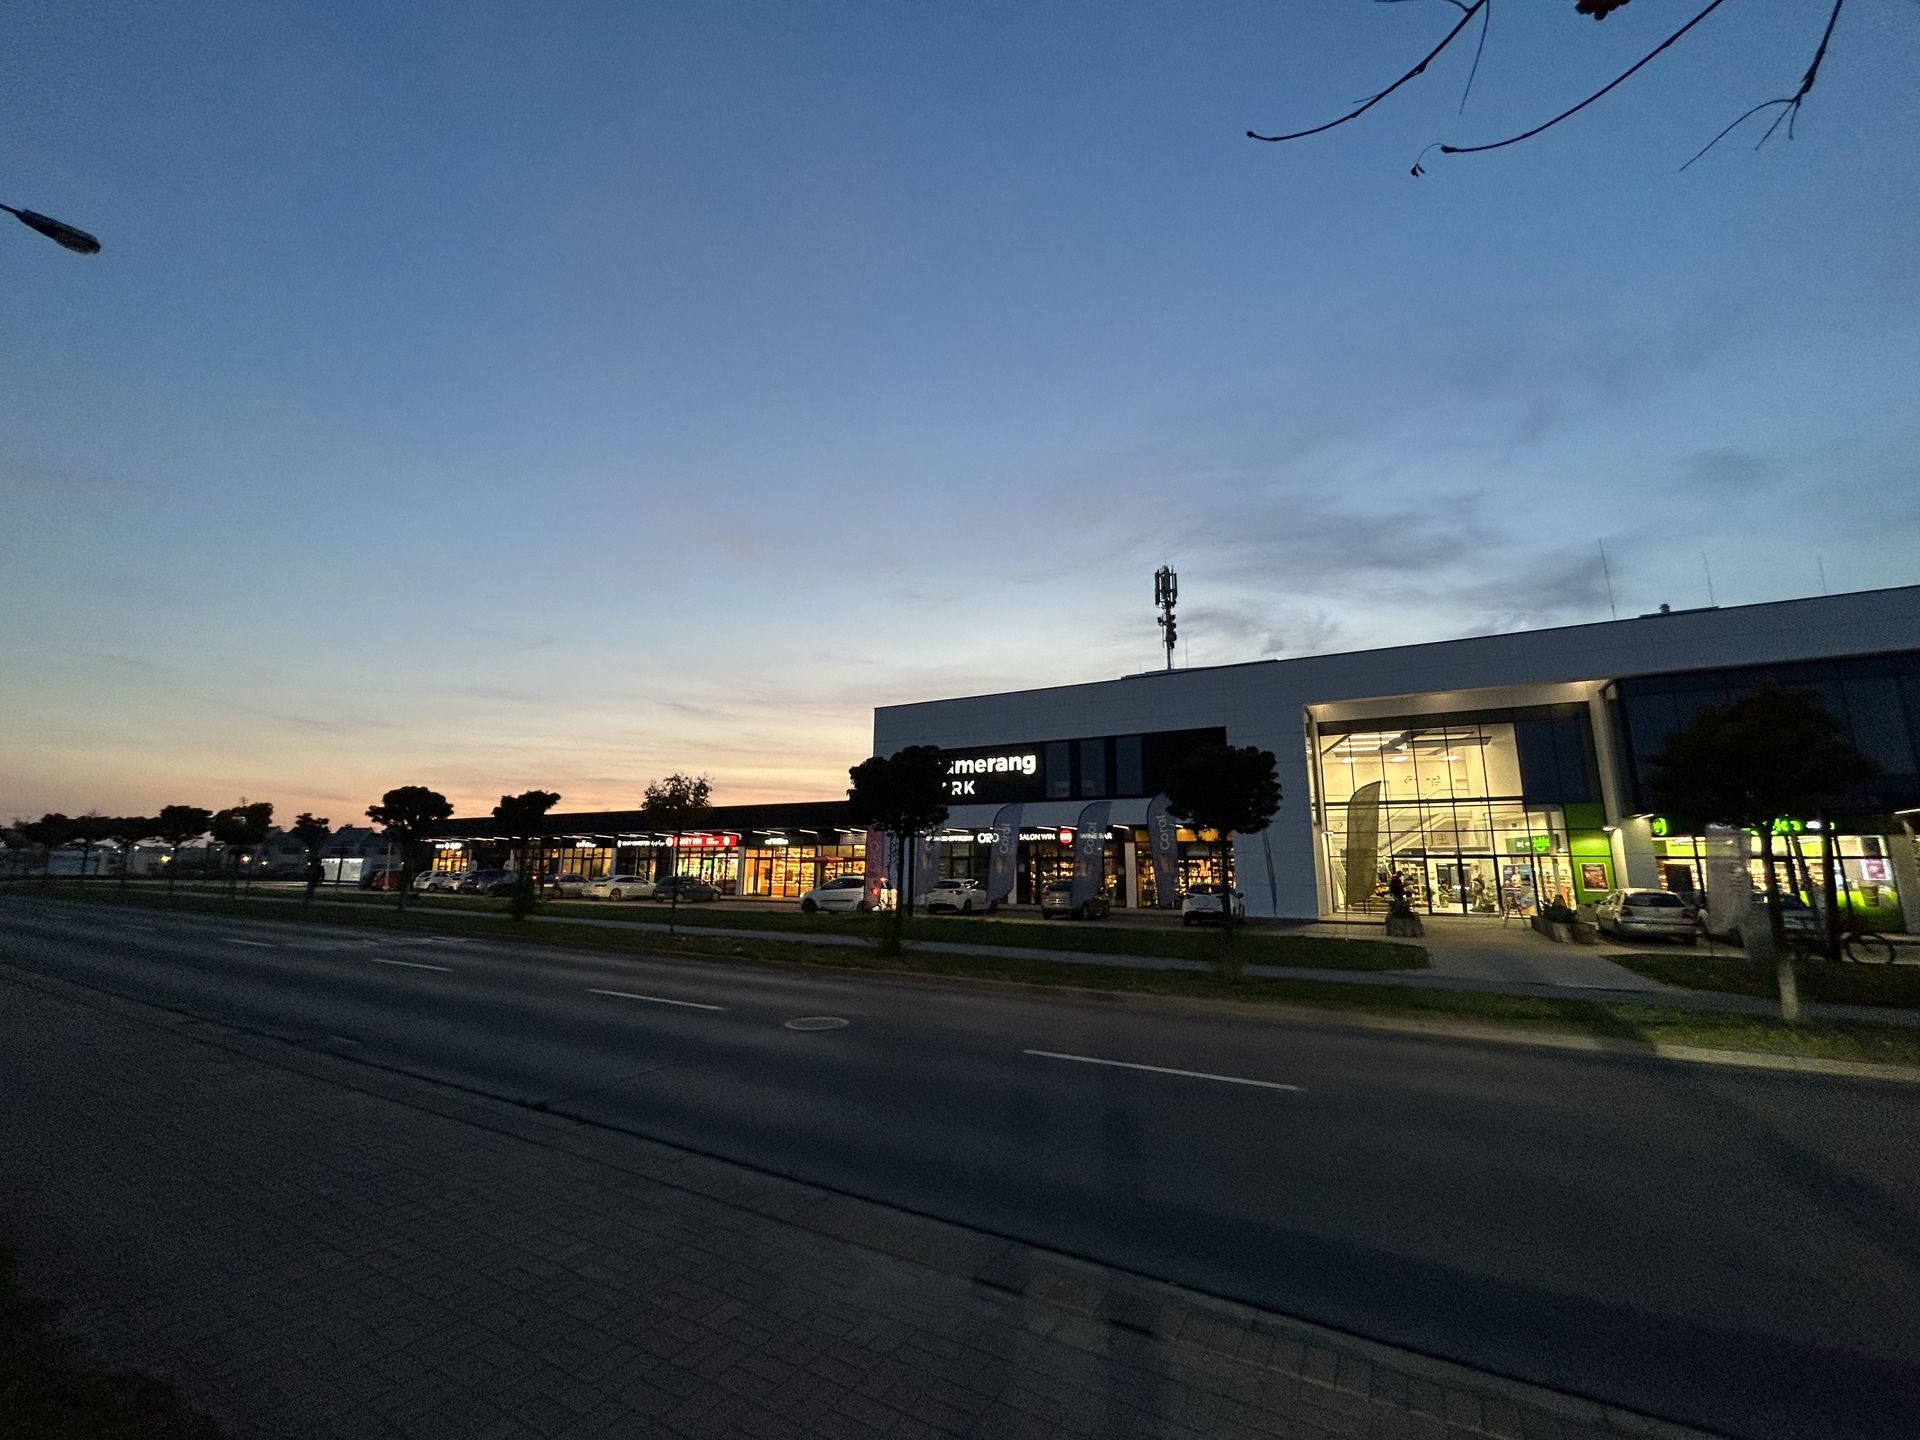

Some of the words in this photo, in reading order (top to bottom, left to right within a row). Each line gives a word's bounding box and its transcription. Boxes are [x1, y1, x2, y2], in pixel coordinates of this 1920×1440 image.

[947, 755, 1036, 775] merang
[942, 780, 976, 795] RK
[1018, 833, 1041, 841] SALON
[1155, 815, 1170, 850] coral
